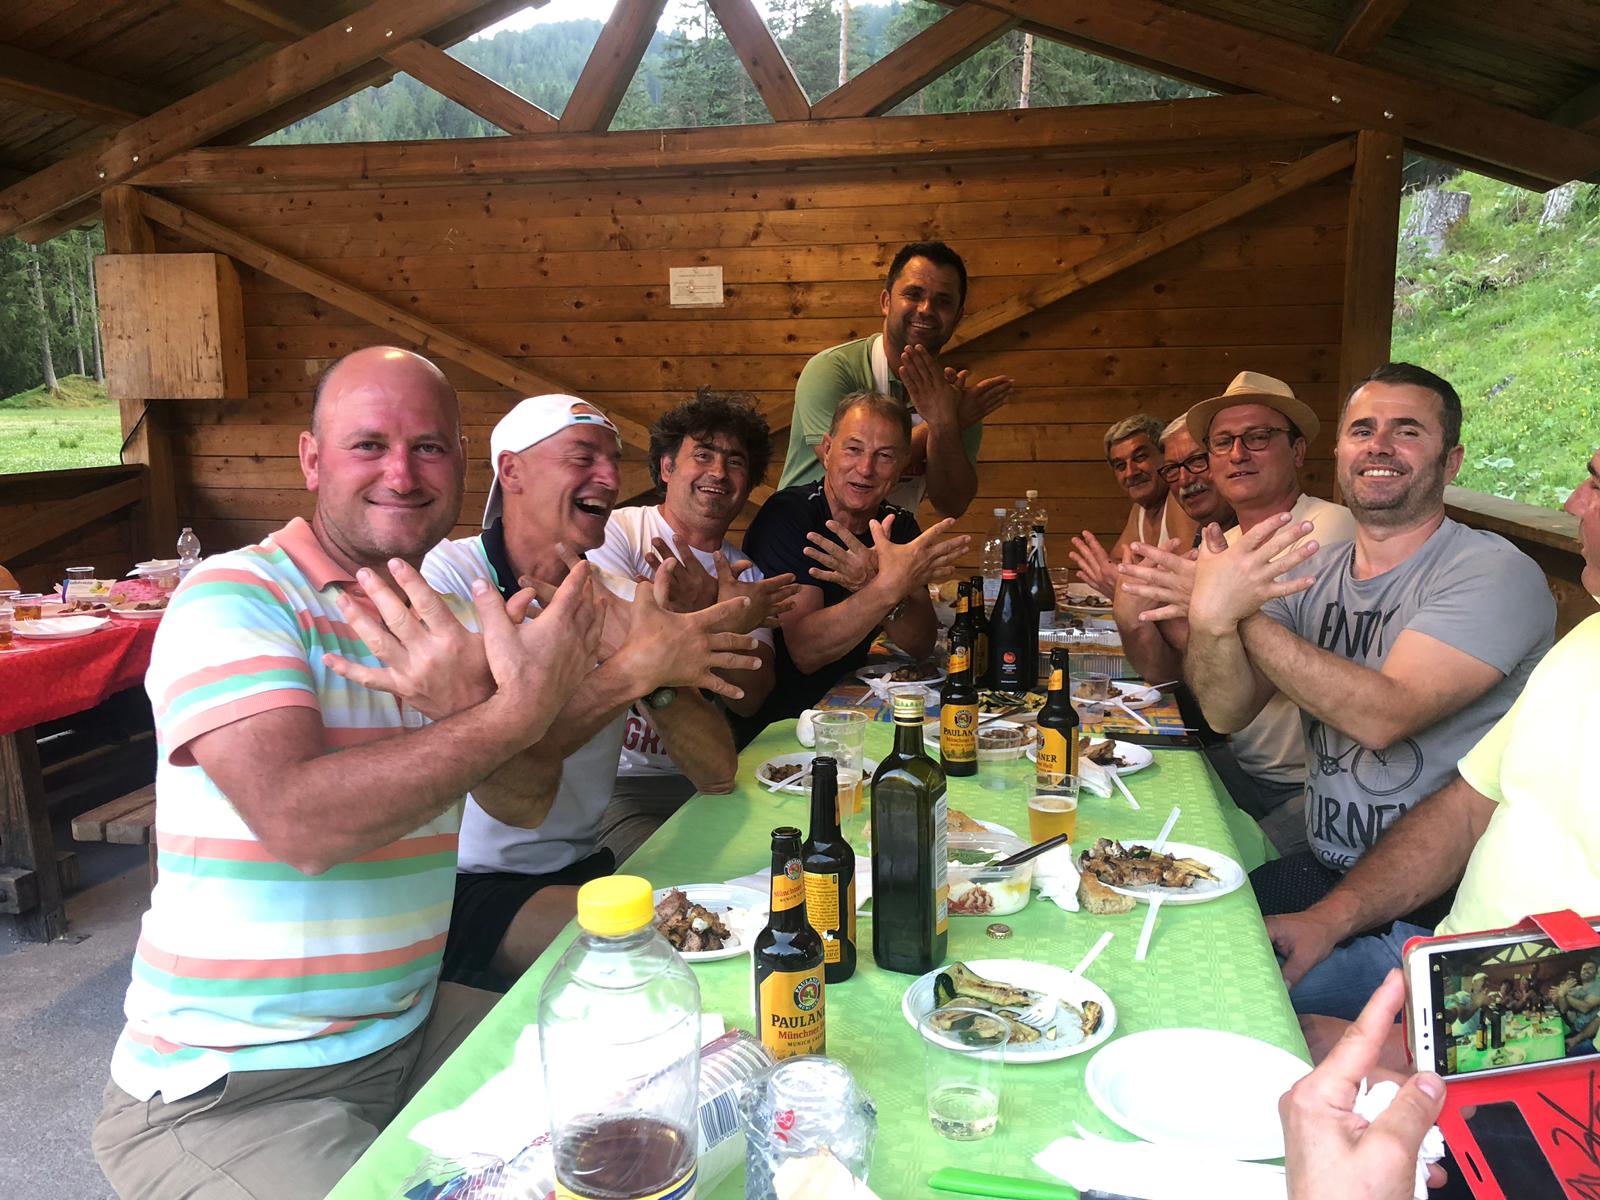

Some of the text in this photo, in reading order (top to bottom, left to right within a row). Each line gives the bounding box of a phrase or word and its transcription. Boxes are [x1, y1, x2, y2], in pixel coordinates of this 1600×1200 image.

[1318, 601, 1401, 658] ENJOY
[624, 717, 667, 755] GR
[943, 727, 974, 737] PAULAN
[771, 1008, 825, 1029] PAULAN
